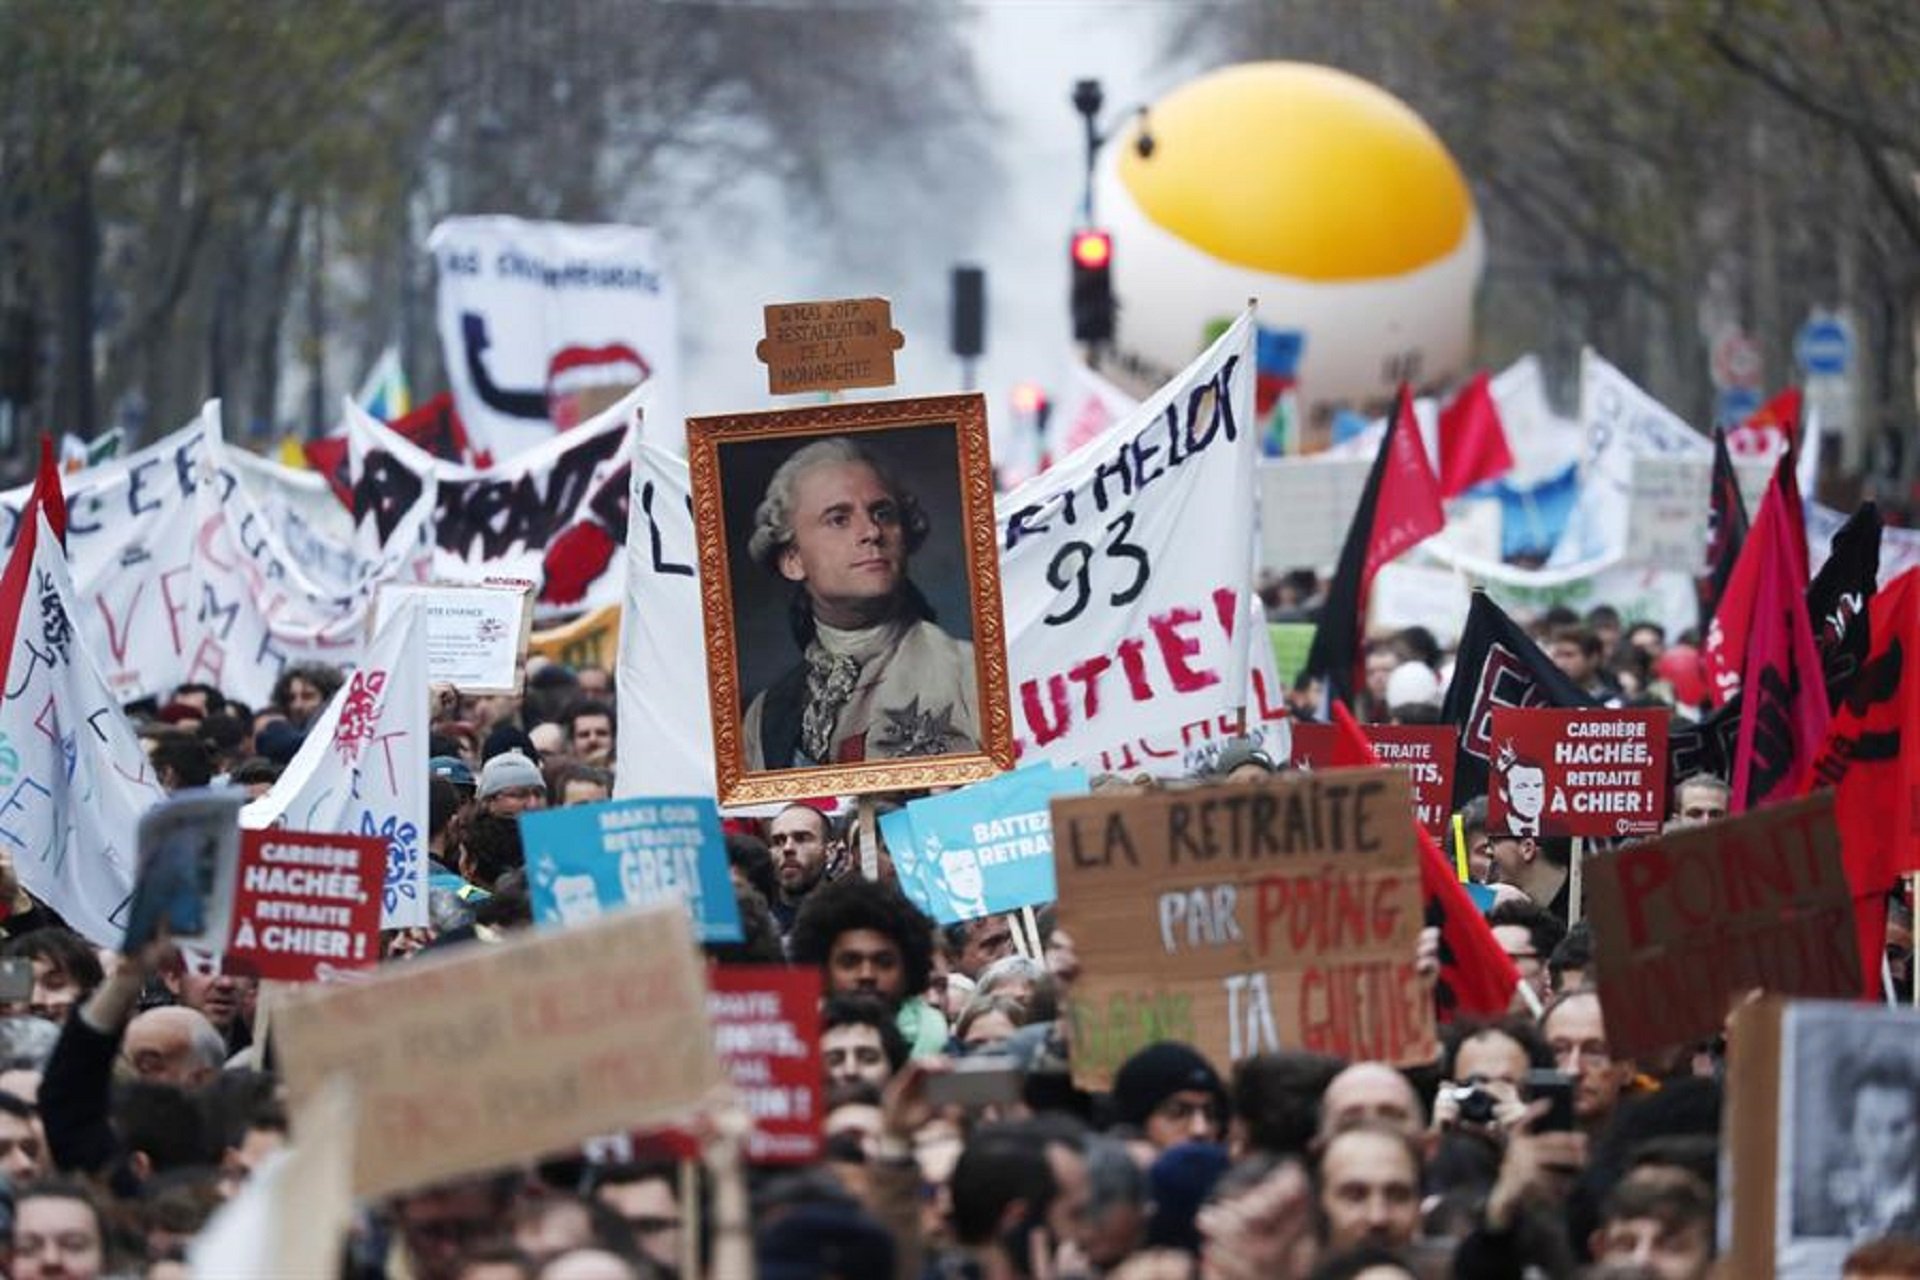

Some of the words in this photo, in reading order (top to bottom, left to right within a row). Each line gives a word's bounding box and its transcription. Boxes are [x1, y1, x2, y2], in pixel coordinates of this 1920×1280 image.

[1044, 510, 1150, 626] 93
[1567, 719, 1646, 738] CARRIÈRE
[1555, 738, 1653, 766] HACHÉE,
[1566, 771, 1641, 786] RETRAITE
[1551, 786, 1568, 812] À
[1572, 792, 1641, 812] CHIER
[1646, 791, 1653, 811] !
[600, 806, 657, 831] MAKE
[660, 805, 699, 823] OUR
[260, 842, 360, 868] CARRIÈRE
[978, 832, 1054, 867] RETRA
[1070, 812, 1138, 868] LA
[244, 865, 368, 905] HACHÉE,
[256, 900, 352, 927] RETRAITE
[1159, 884, 1243, 956] PAR
[235, 917, 257, 950] À
[261, 925, 350, 958] CHIER
[1225, 972, 1280, 1060] TA
